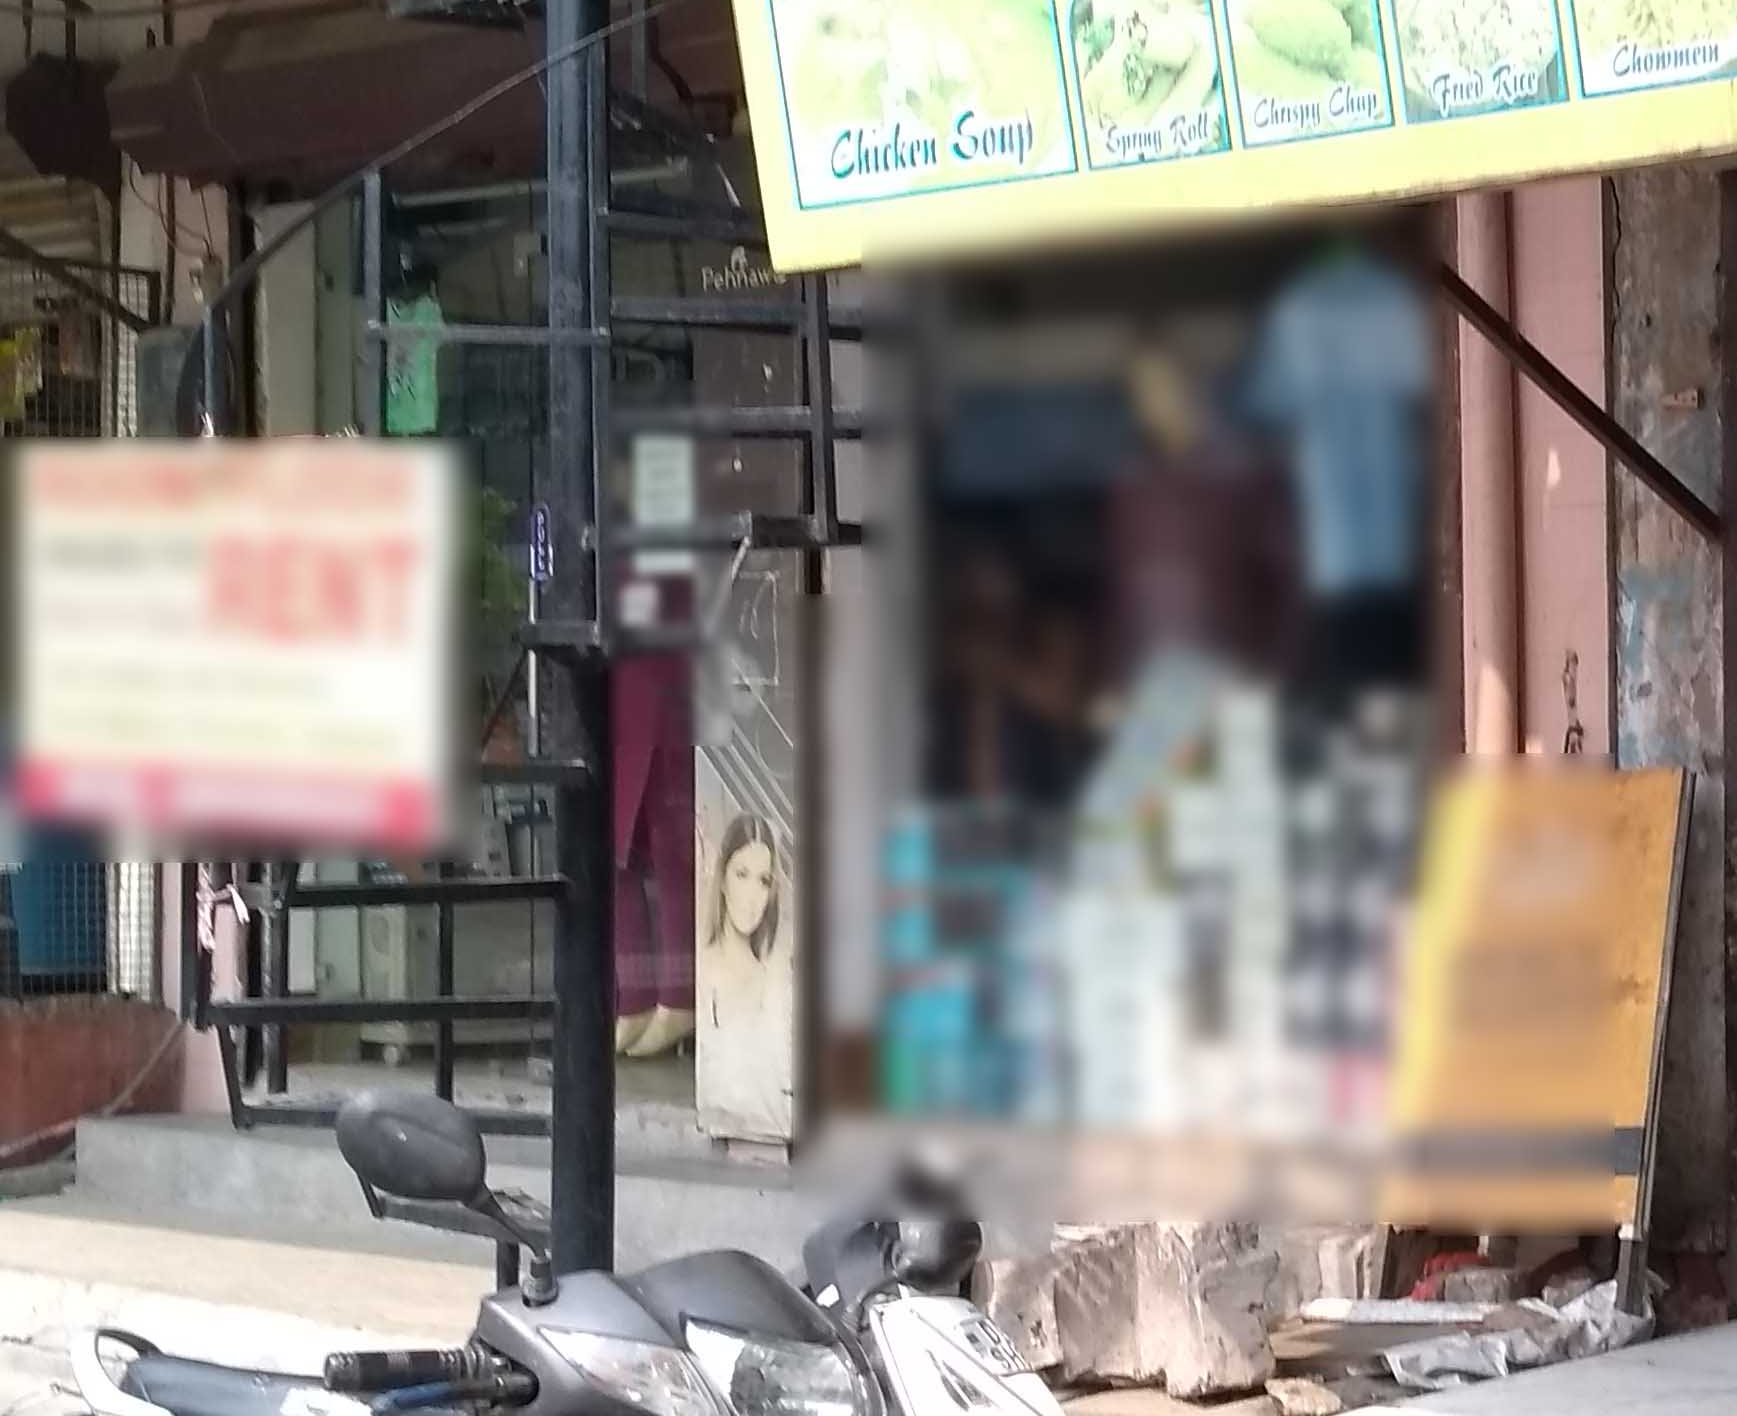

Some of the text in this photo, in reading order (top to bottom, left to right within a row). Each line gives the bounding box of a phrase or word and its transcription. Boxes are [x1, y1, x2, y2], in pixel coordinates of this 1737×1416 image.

[1612, 40, 1720, 78] Chowmein
[1432, 63, 1537, 116] Fried Rice
[830, 106, 1035, 179] Chicken Soup
[1104, 112, 1209, 161] Spring Roll
